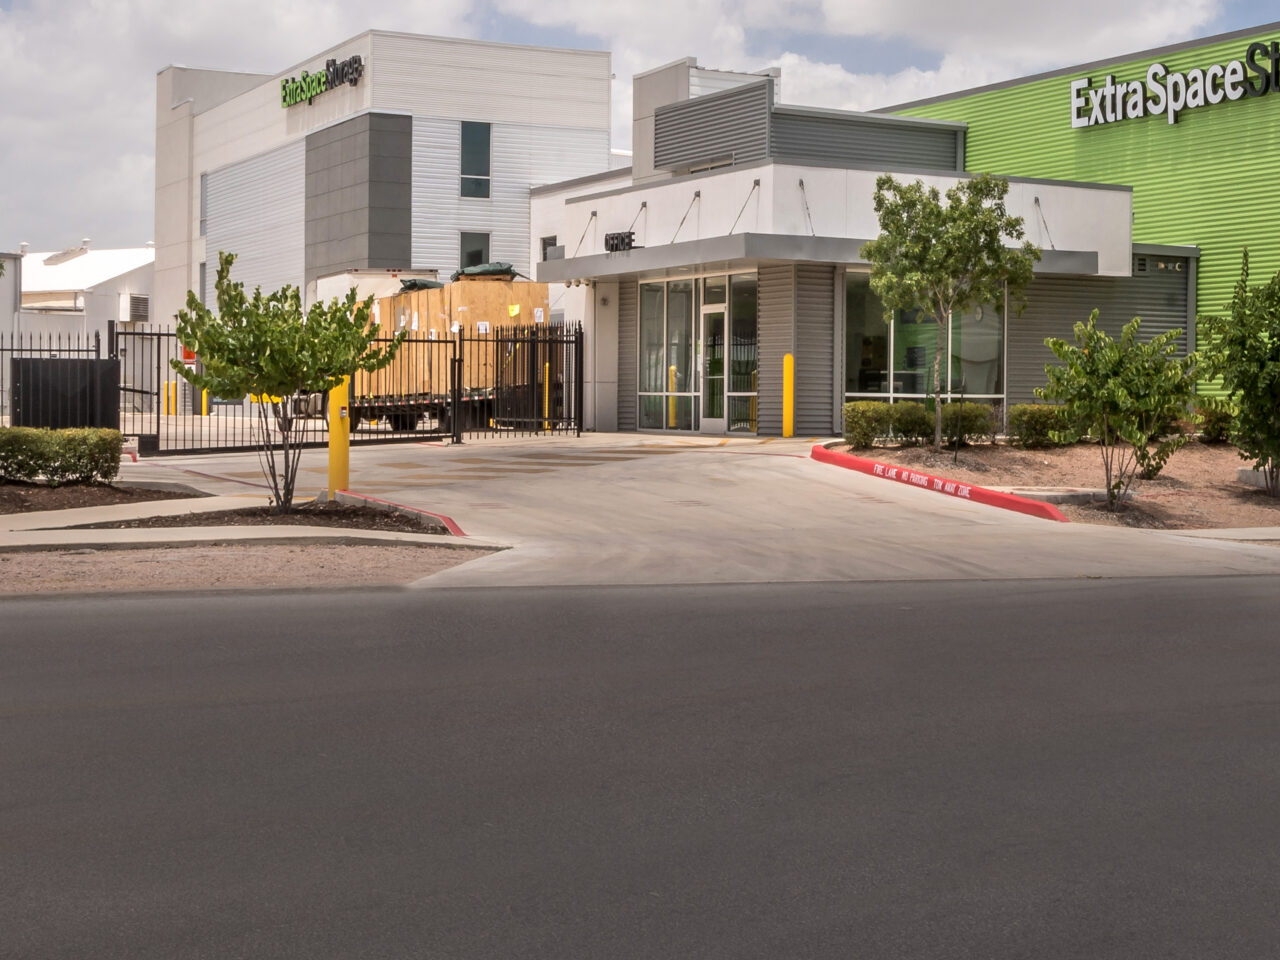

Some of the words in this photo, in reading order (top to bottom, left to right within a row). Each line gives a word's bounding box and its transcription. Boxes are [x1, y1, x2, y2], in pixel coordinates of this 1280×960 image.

[325, 55, 362, 87] Storage
[605, 232, 635, 252] OFFICE
[873, 464, 884, 475] FIRE
[885, 467, 898, 479] LANE
[901, 470, 909, 481] NO
[910, 472, 929, 486] PARKING
[933, 478, 943, 491] TOW
[944, 481, 956, 493] AWAY
[957, 484, 972, 498] ZONE
